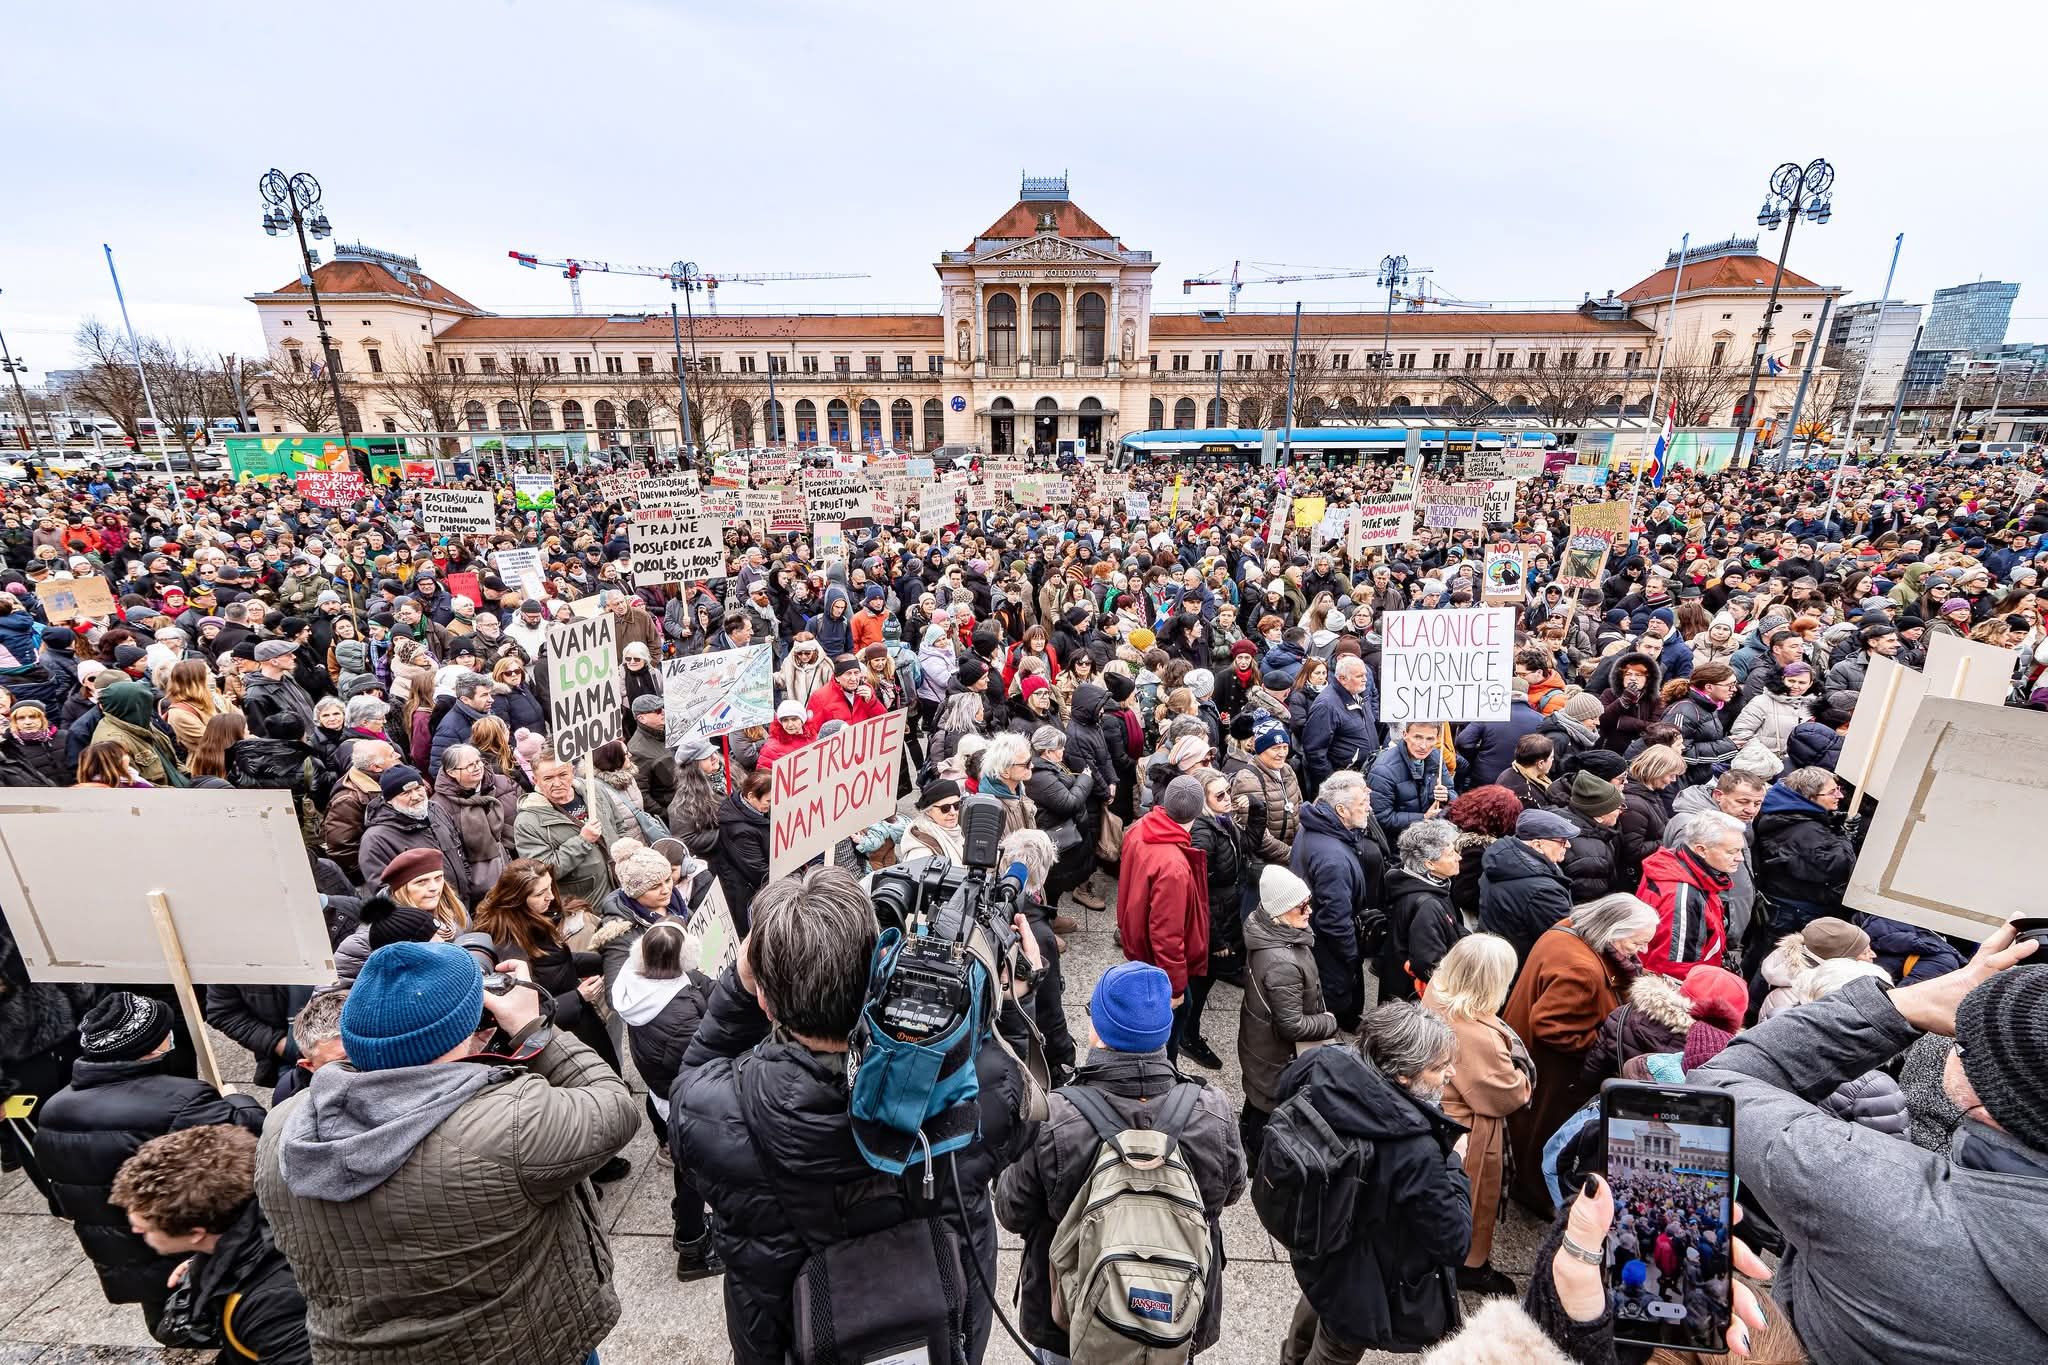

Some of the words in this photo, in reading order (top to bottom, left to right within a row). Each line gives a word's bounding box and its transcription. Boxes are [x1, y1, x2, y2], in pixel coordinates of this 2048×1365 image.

[1000, 269, 1034, 278] GLAVNI
[1044, 269, 1098, 278] KOLODVOR
[601, 480, 620, 488] NEMA
[640, 489, 669, 500] DNEVNA
[808, 485, 868, 498] MEGAKLAONICA
[875, 492, 888, 501] NE
[423, 493, 484, 505] ZASTRAŠUJUĆA
[809, 500, 818, 511] JE
[819, 498, 860, 511] PRIJETNJA
[1467, 496, 1485, 507] TLU
[426, 503, 468, 513] KOLIČINA
[469, 518, 491, 526] VODA
[635, 510, 656, 521] PROFIT
[439, 524, 477, 533] DNEVNO
[637, 521, 699, 537] TRAJNE
[1361, 518, 1382, 529] PITKE
[1383, 517, 1401, 527] VODE
[1361, 527, 1399, 540] GODIŠNJE
[1575, 526, 1615, 544] VRISAK
[633, 539, 696, 556] POSLJEDICE
[697, 536, 713, 548] ZA
[1494, 543, 1511, 554] NO
[1512, 543, 1521, 556] A
[633, 556, 678, 574] OKOLIŠ
[682, 558, 690, 568] U
[692, 551, 723, 568] KORIST
[663, 567, 709, 581] PROFITA
[1560, 576, 1593, 589] SISAK
[1386, 612, 1501, 648] KLAONICE
[549, 618, 611, 659] VAMA
[1386, 651, 1500, 682] TVORNICE
[554, 679, 616, 731] NAMA
[1392, 684, 1482, 720] SMRTI
[557, 708, 622, 763] GNOJ!
[774, 750, 809, 806] NE
[812, 713, 902, 784] TRUJTE
[774, 796, 825, 859] NAM
[833, 761, 892, 822] DOM
[923, 950, 941, 958] SONY
[897, 1031, 921, 1043] Dyna
[1660, 1112, 1680, 1121] 00:04
[1131, 1297, 1171, 1313] JANSPORT
